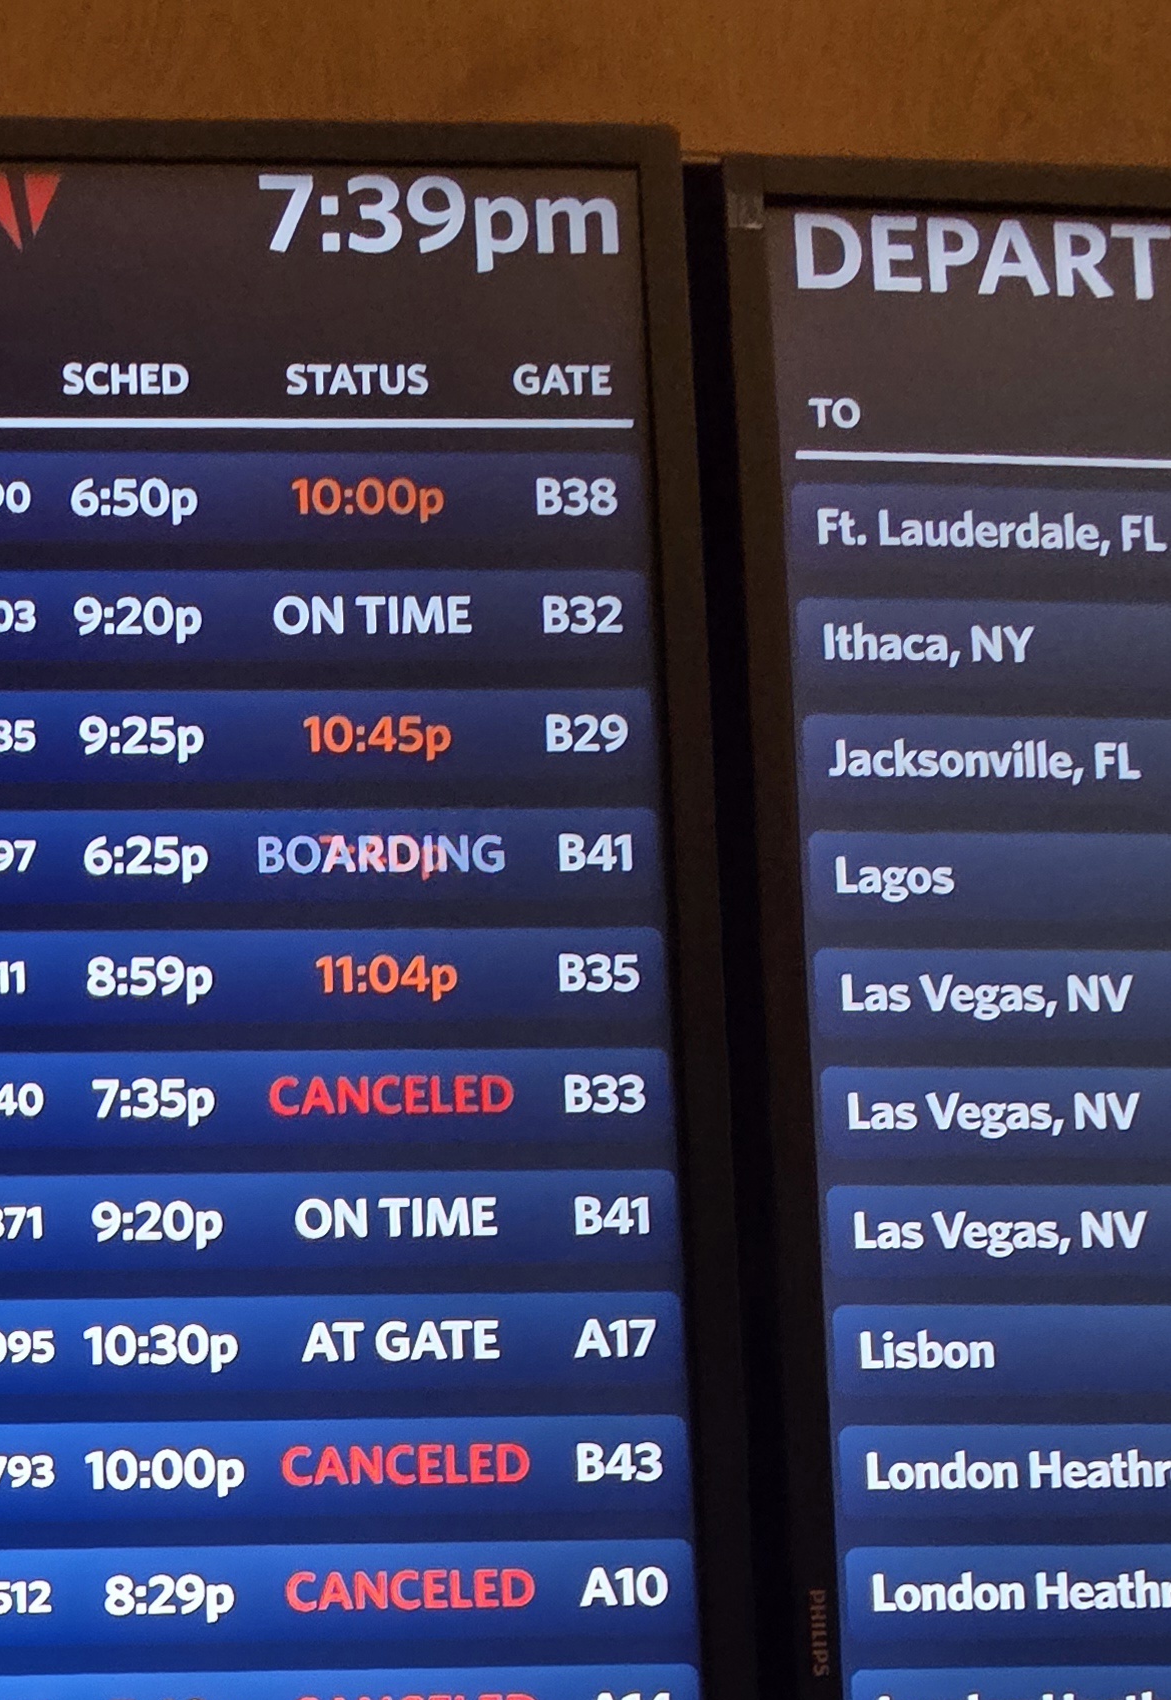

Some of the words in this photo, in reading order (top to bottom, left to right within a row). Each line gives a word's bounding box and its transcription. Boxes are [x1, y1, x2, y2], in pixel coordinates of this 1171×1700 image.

[258, 174, 619, 273] 7:39pm
[62, 361, 190, 395] SCHED
[286, 363, 429, 395] STATUS
[513, 363, 612, 396] GATE
[808, 397, 861, 429] TO
[70, 477, 198, 526] 6:50p
[291, 477, 444, 524] 10:00p
[536, 477, 618, 516] B38
[817, 507, 867, 546] Ft.
[878, 508, 1111, 557] Lauderdale,
[1121, 514, 1168, 552] FL
[273, 595, 344, 636] ON
[355, 595, 473, 635] TIME
[823, 621, 961, 668] Ithaca,
[970, 624, 1035, 663] NY
[303, 715, 452, 762] 10:45p
[828, 737, 1085, 786] Jacksonville,
[1094, 741, 1142, 780] FL
[257, 834, 507, 874] BOARDING
[835, 855, 955, 903] Lagos
[315, 954, 458, 1002] 11:04p
[558, 953, 640, 993] B35
[841, 973, 912, 1013] Las
[918, 973, 1058, 1021] Vegas,
[1067, 974, 1134, 1013] NV
[268, 1074, 514, 1117] CANCELED
[847, 1091, 918, 1131] Las
[924, 1091, 1065, 1139] Vegas,
[1073, 1091, 1141, 1130] NV
[83, 1323, 239, 1373] 10:30p
[301, 1321, 365, 1363] AT
[375, 1319, 501, 1362] GATE
[574, 1318, 657, 1359] A17
[859, 1329, 995, 1370] Lisbon
[865, 1449, 1019, 1491] London
[104, 1573, 235, 1624] 8:29p
[284, 1568, 536, 1613] CANCELED
[579, 1566, 669, 1607] A10
[809, 1589, 830, 1677] PHILIPS
